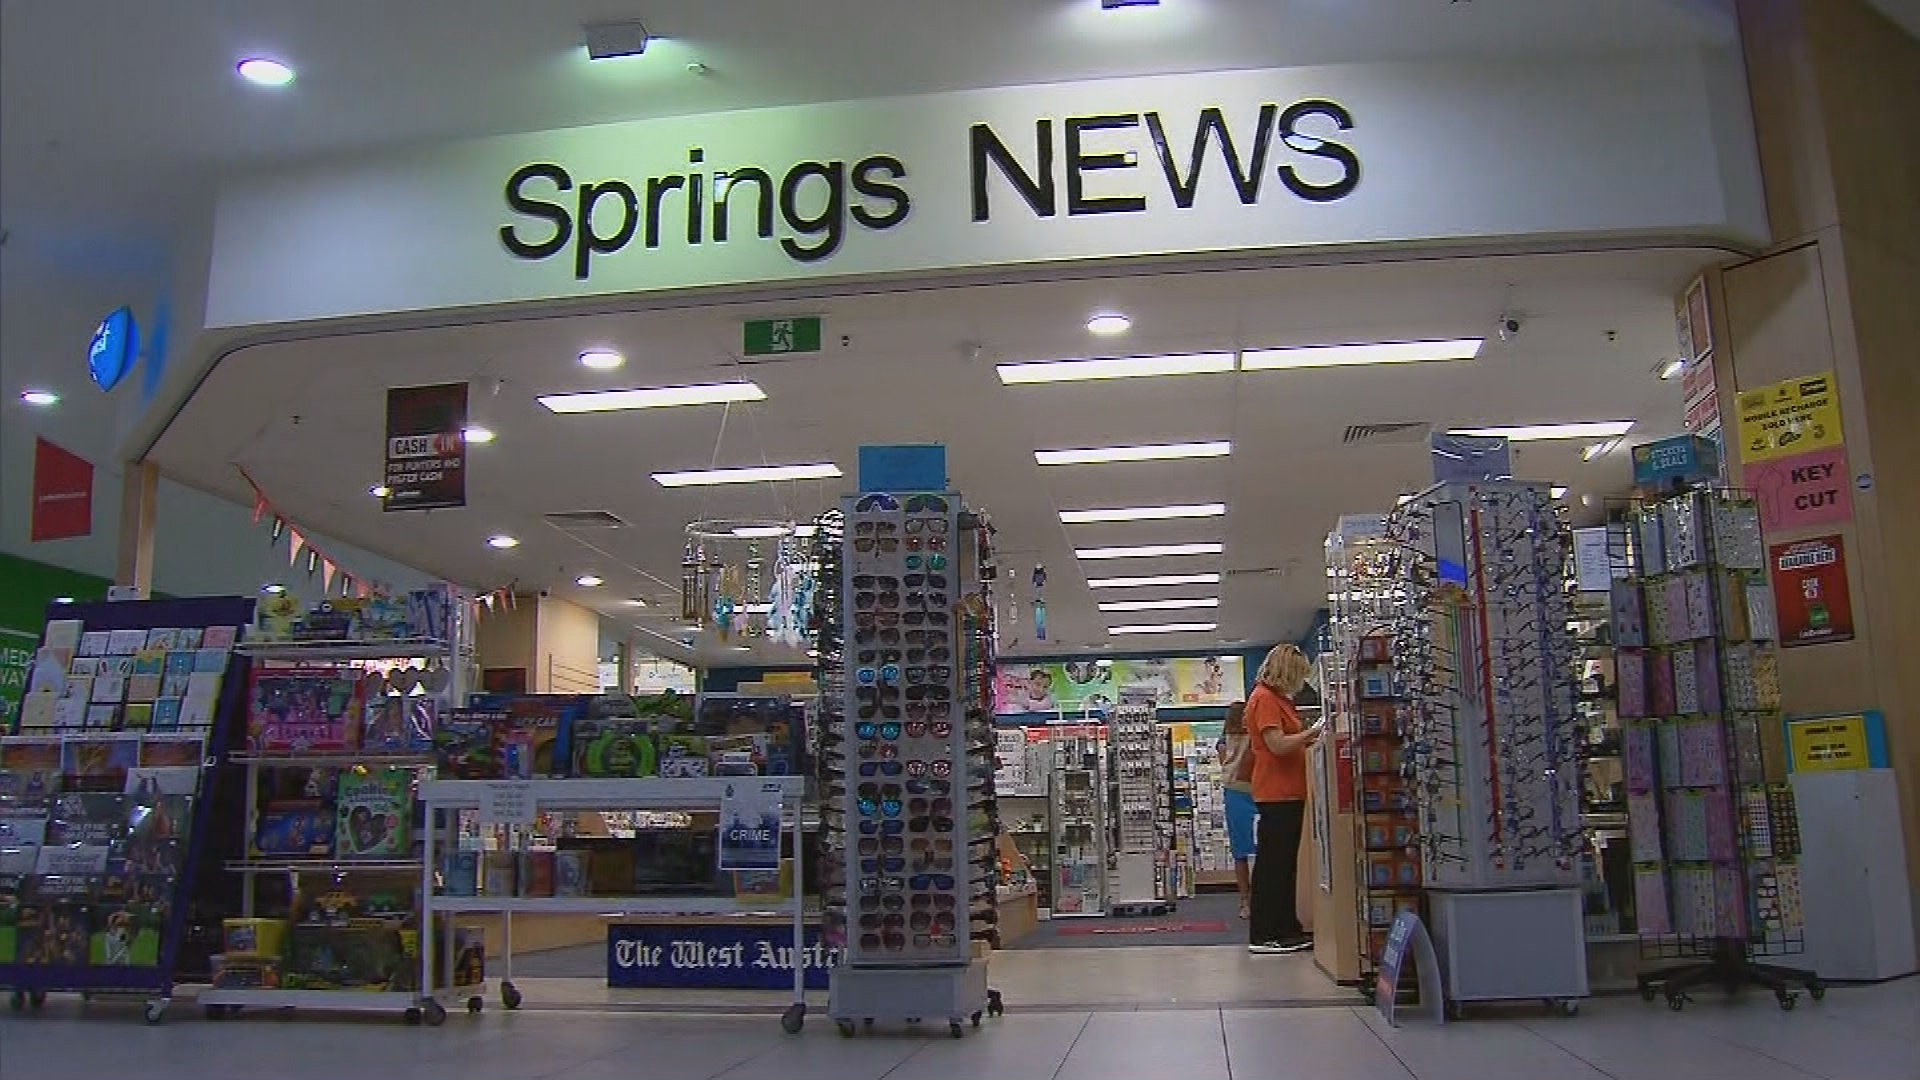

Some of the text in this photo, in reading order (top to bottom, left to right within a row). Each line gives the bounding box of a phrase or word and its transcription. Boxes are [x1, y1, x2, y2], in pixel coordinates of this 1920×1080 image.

[500, 98, 1361, 280] Springs NEWS
[1744, 409, 1778, 423] MOBILE
[1779, 398, 1829, 416] RECHARGE
[1761, 419, 1786, 431] SOLD
[395, 438, 428, 455] CASH
[1791, 462, 1835, 484] KEY
[1794, 489, 1839, 511] CUT
[730, 829, 771, 841] CRIME
[615, 939, 663, 968] The
[670, 941, 745, 969] West
